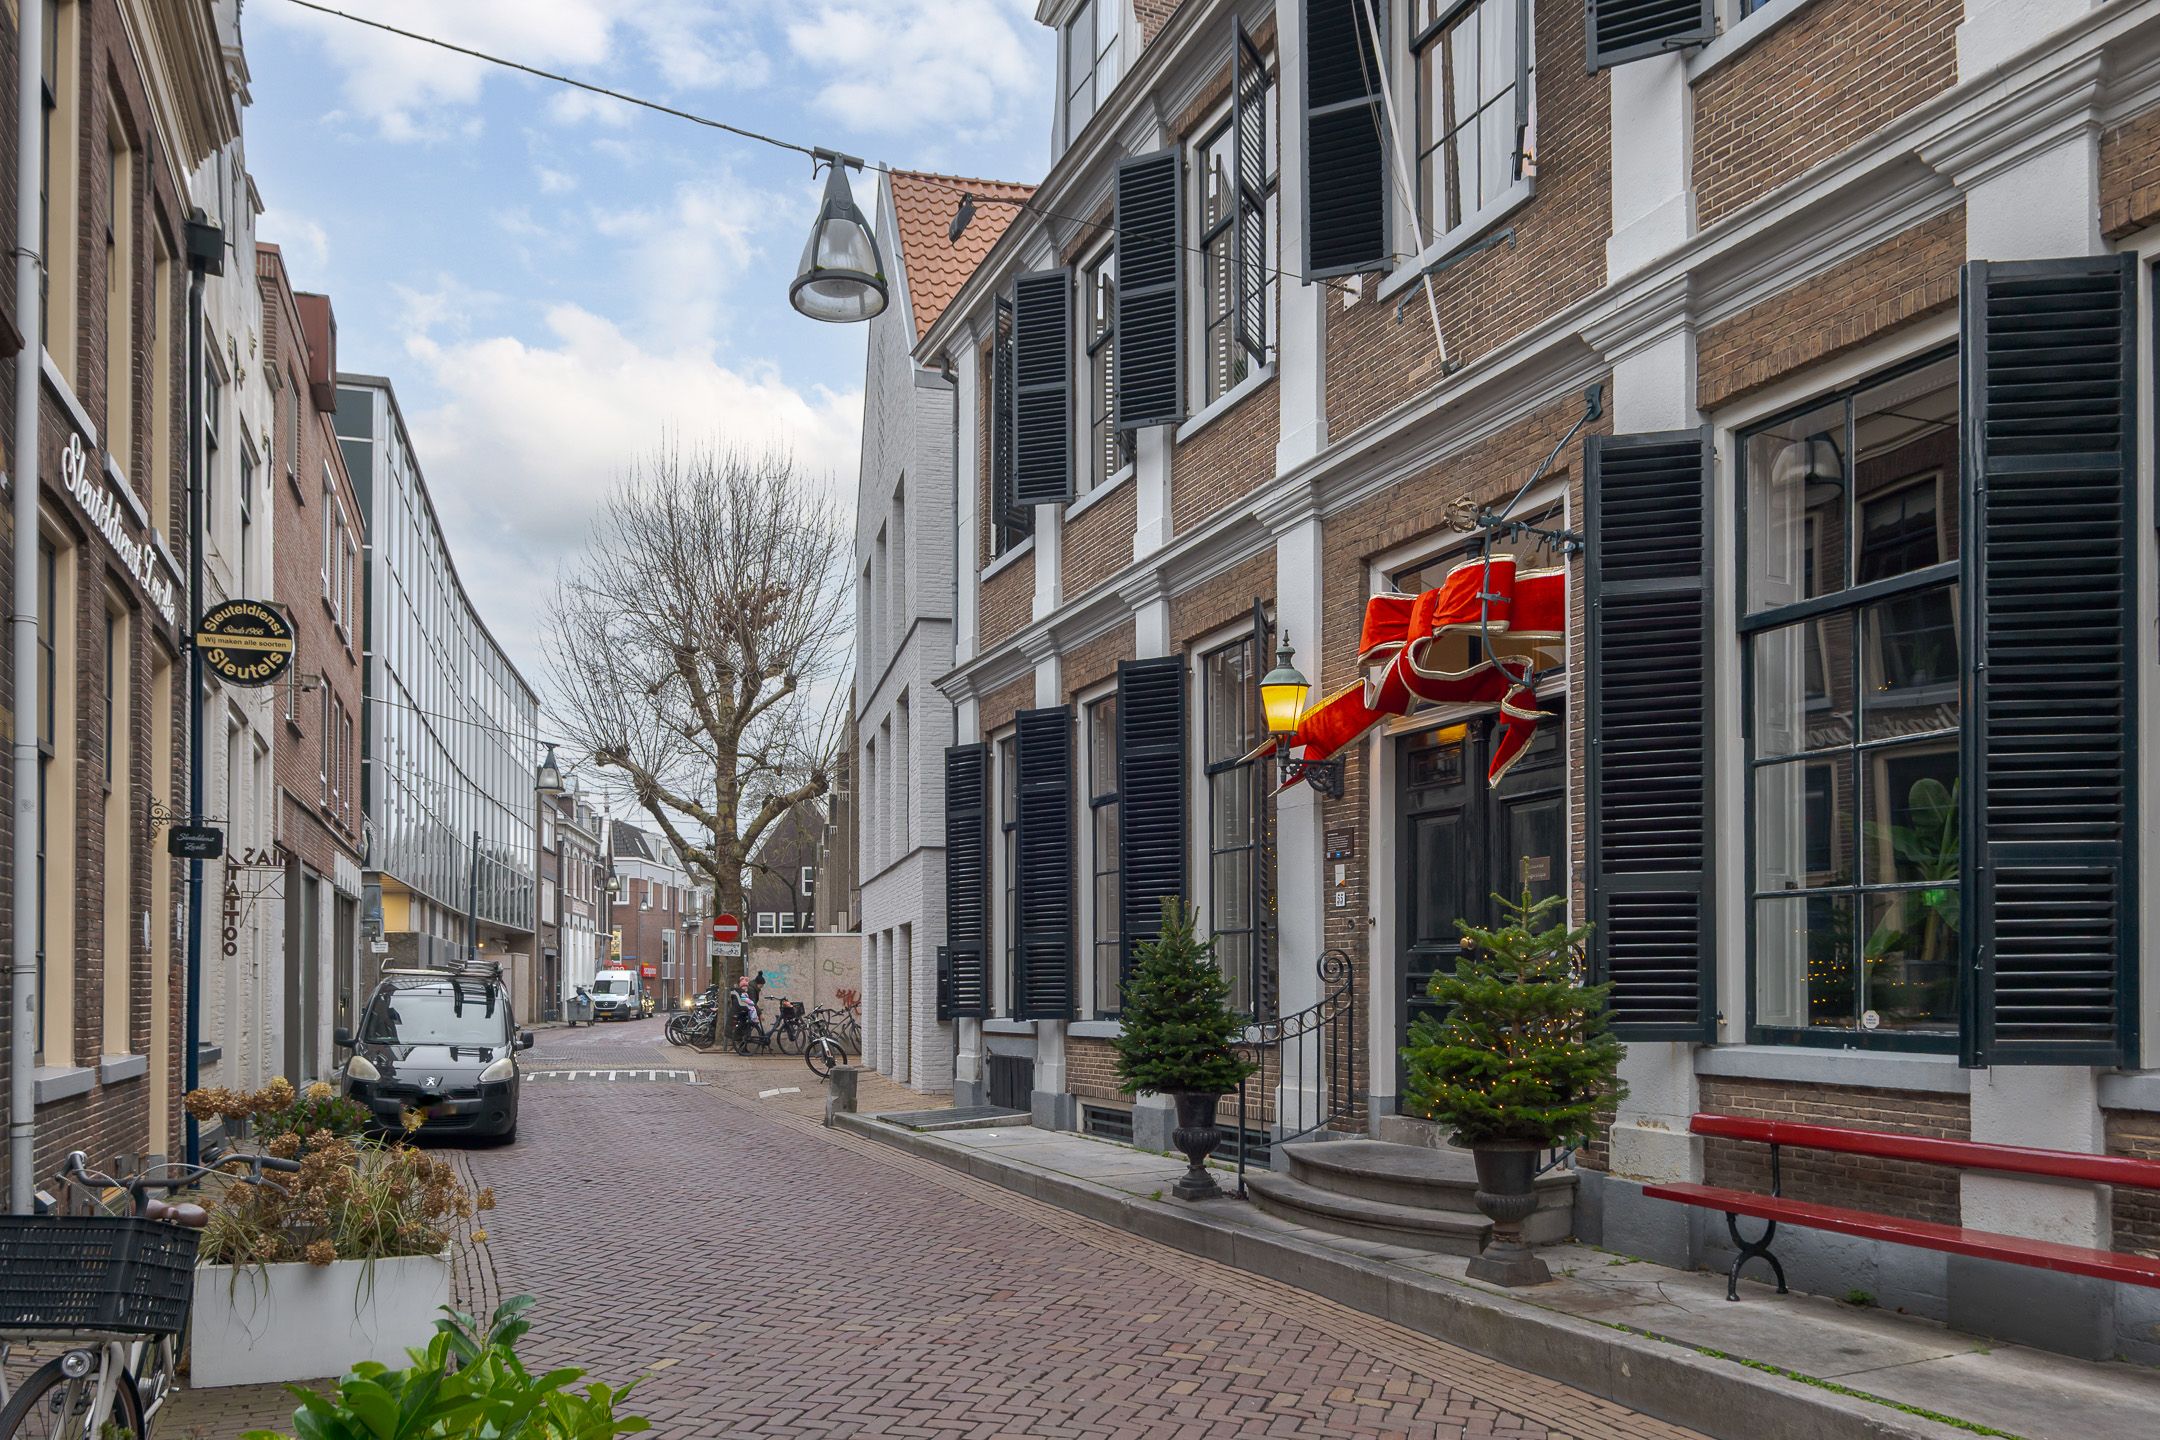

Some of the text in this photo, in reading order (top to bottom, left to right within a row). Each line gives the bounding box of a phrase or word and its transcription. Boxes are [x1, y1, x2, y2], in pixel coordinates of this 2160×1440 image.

[61, 432, 142, 581] Sleuteldienst
[204, 603, 285, 636] Sleuteldienst
[245, 627, 265, 636] 1966
[204, 636, 216, 645] Wij
[217, 637, 242, 646] maken
[207, 648, 284, 679] Sleutels
[223, 865, 242, 957] TATTOO
